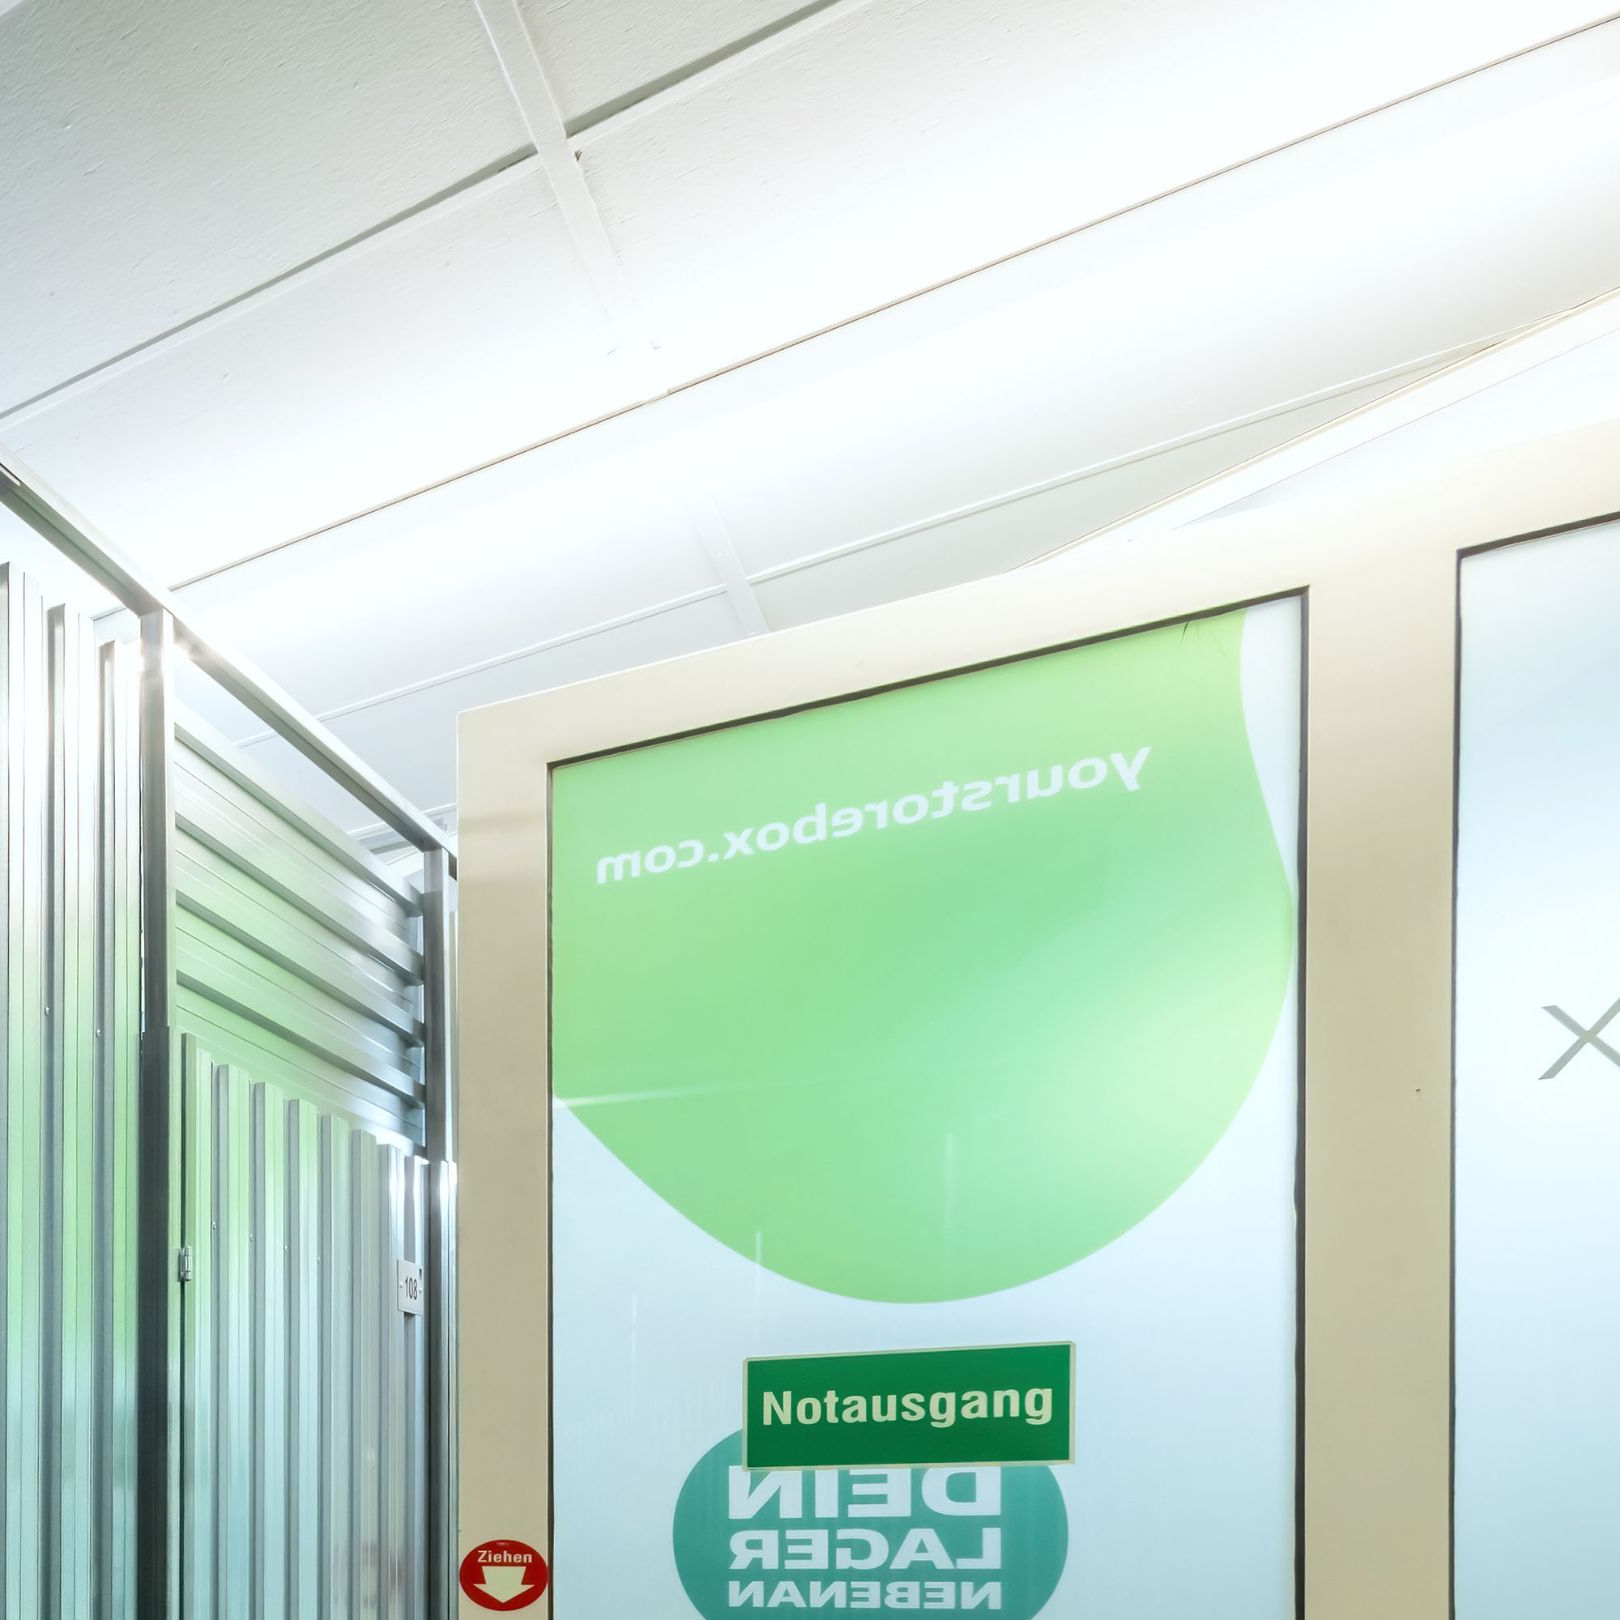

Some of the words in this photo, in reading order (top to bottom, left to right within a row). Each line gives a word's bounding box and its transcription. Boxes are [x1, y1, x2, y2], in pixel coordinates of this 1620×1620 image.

[405, 1276, 418, 1300] 108
[762, 1386, 1054, 1428] Notausgang
[477, 1550, 533, 1564] Ziehen
